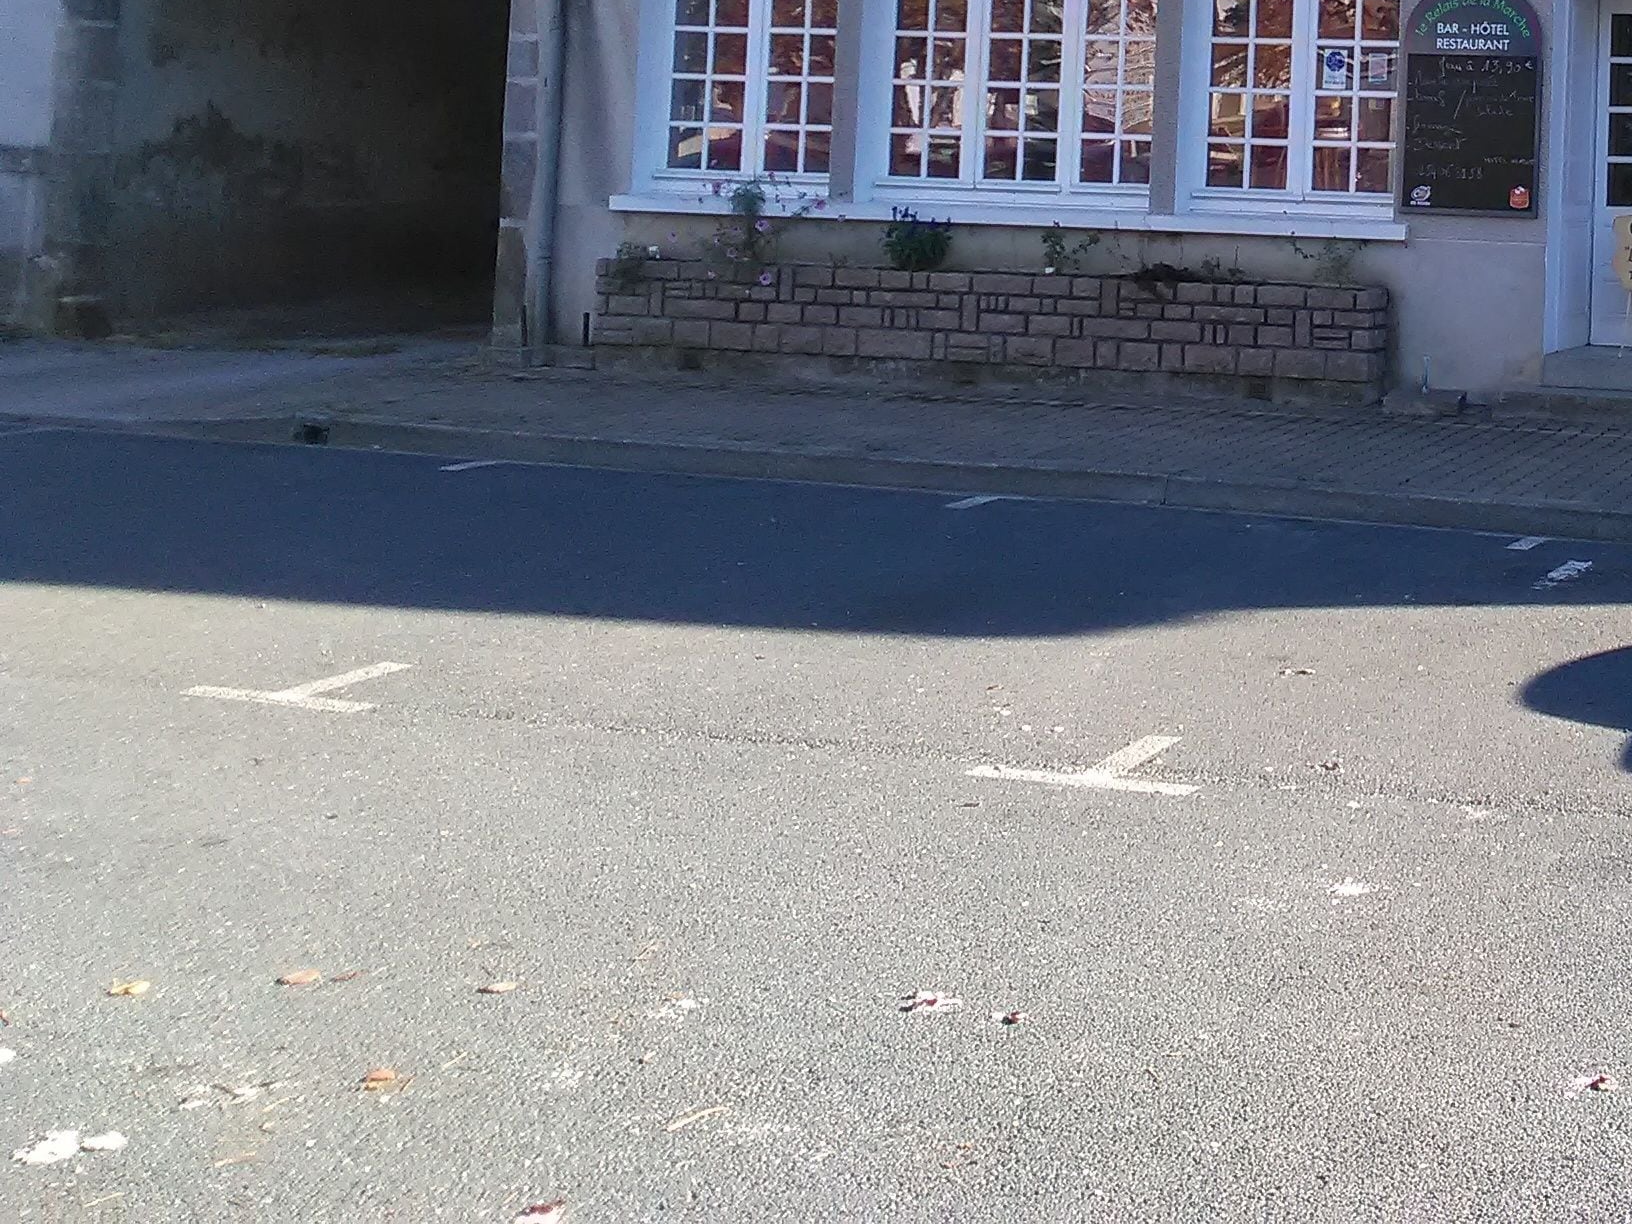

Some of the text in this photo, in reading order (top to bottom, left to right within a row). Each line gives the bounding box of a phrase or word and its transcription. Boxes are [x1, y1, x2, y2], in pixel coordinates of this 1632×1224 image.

[1437, 23, 1459, 34] BAR
[1471, 21, 1509, 36] HÔTEL
[1436, 38, 1510, 51] RESTAURANT
